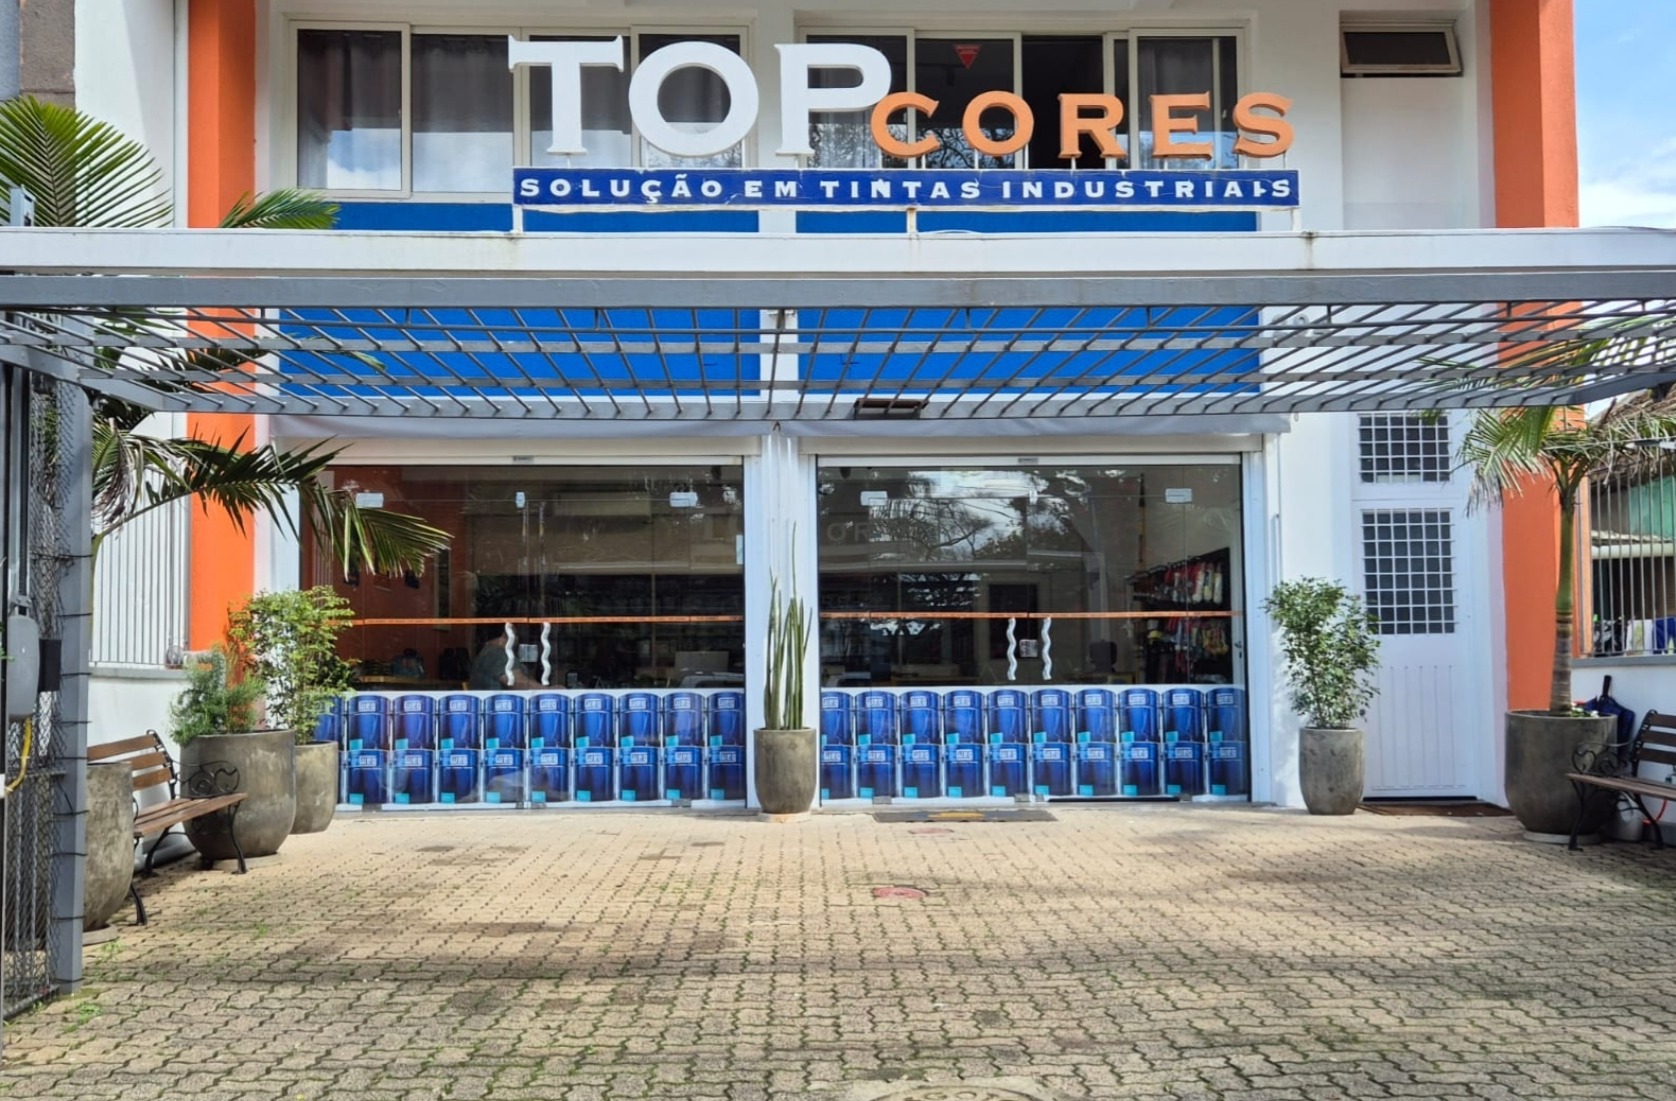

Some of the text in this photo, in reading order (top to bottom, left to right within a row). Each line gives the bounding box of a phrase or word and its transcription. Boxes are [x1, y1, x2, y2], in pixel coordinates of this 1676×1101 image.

[508, 35, 1295, 160] TOP CORES
[520, 173, 1291, 204] SOLUÇÃO EM TINTAS INDUSTRIAIS
